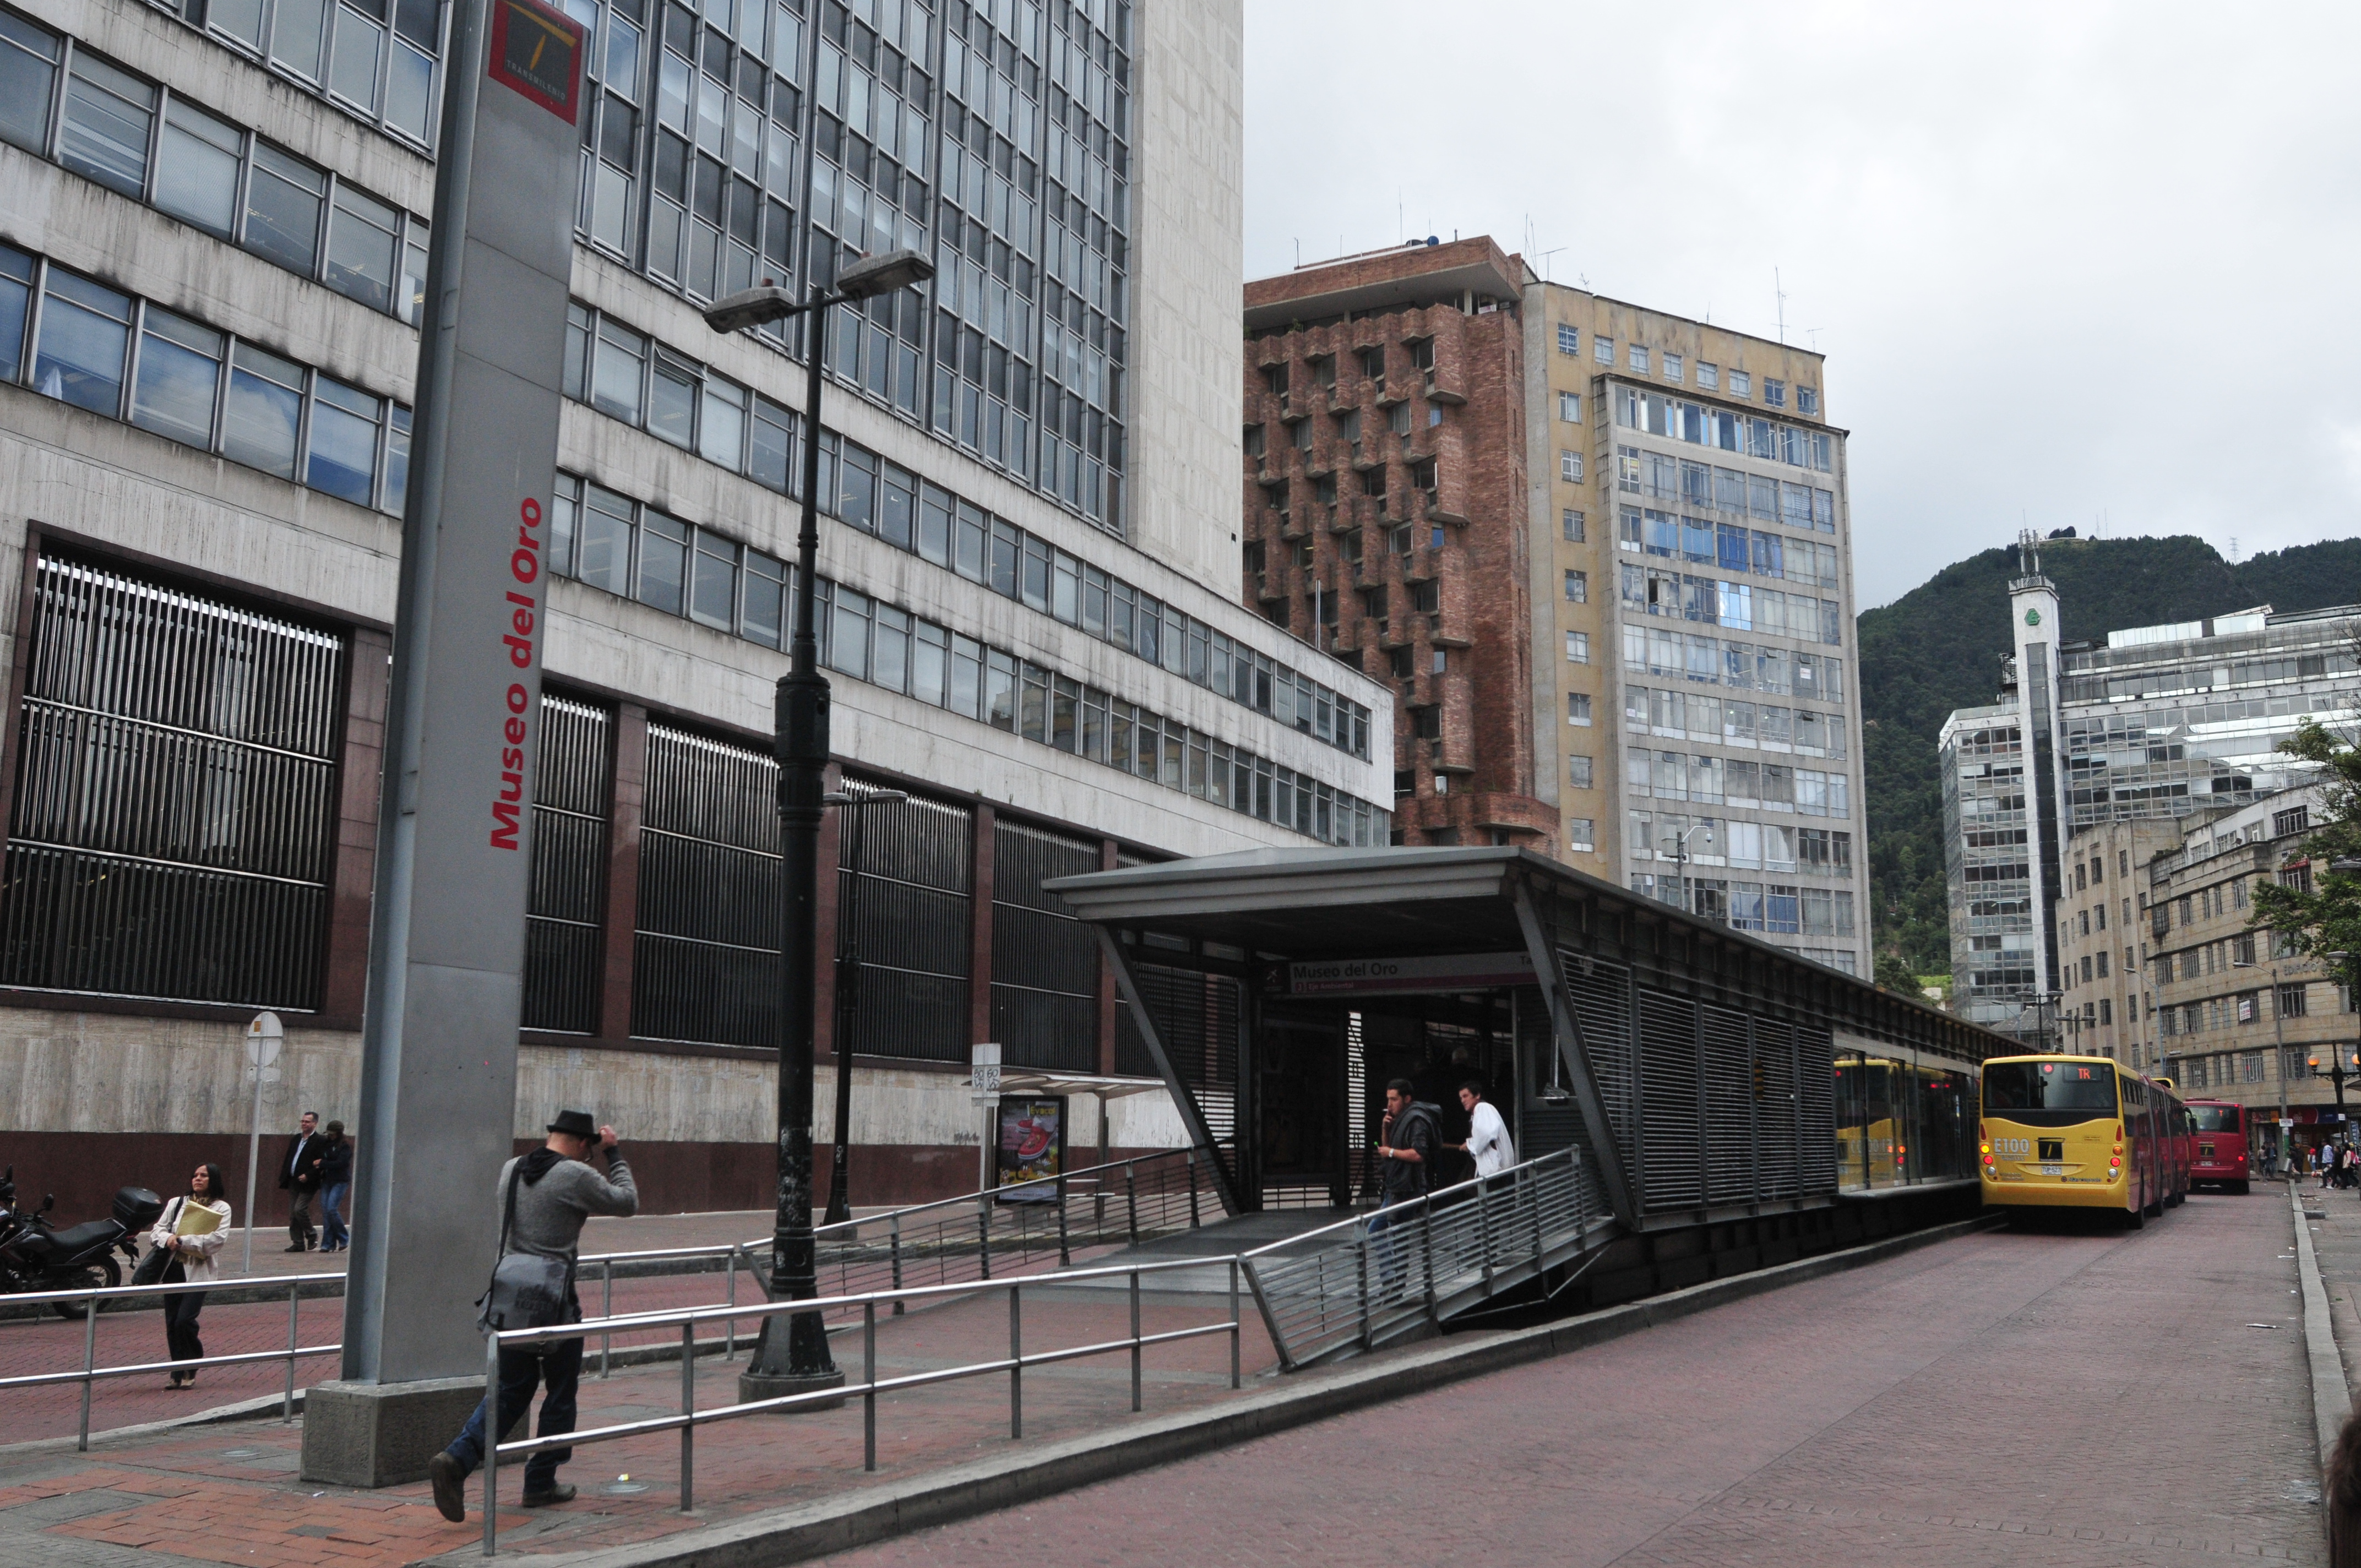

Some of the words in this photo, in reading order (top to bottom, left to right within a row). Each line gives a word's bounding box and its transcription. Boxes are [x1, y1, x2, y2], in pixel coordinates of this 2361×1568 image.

[507, 59, 566, 101] TRANSMILENIO
[511, 497, 541, 584] Oro
[503, 591, 535, 668] del
[490, 683, 528, 851] Museo
[1520, 956, 1532, 965] Ta
[1293, 966, 1341, 979] Museo
[1345, 963, 1366, 977] del
[1370, 962, 1398, 976] Oro
[1320, 982, 1354, 990] Ambiental
[2078, 1068, 2091, 1079] TR
[1994, 1138, 2029, 1152] E100
